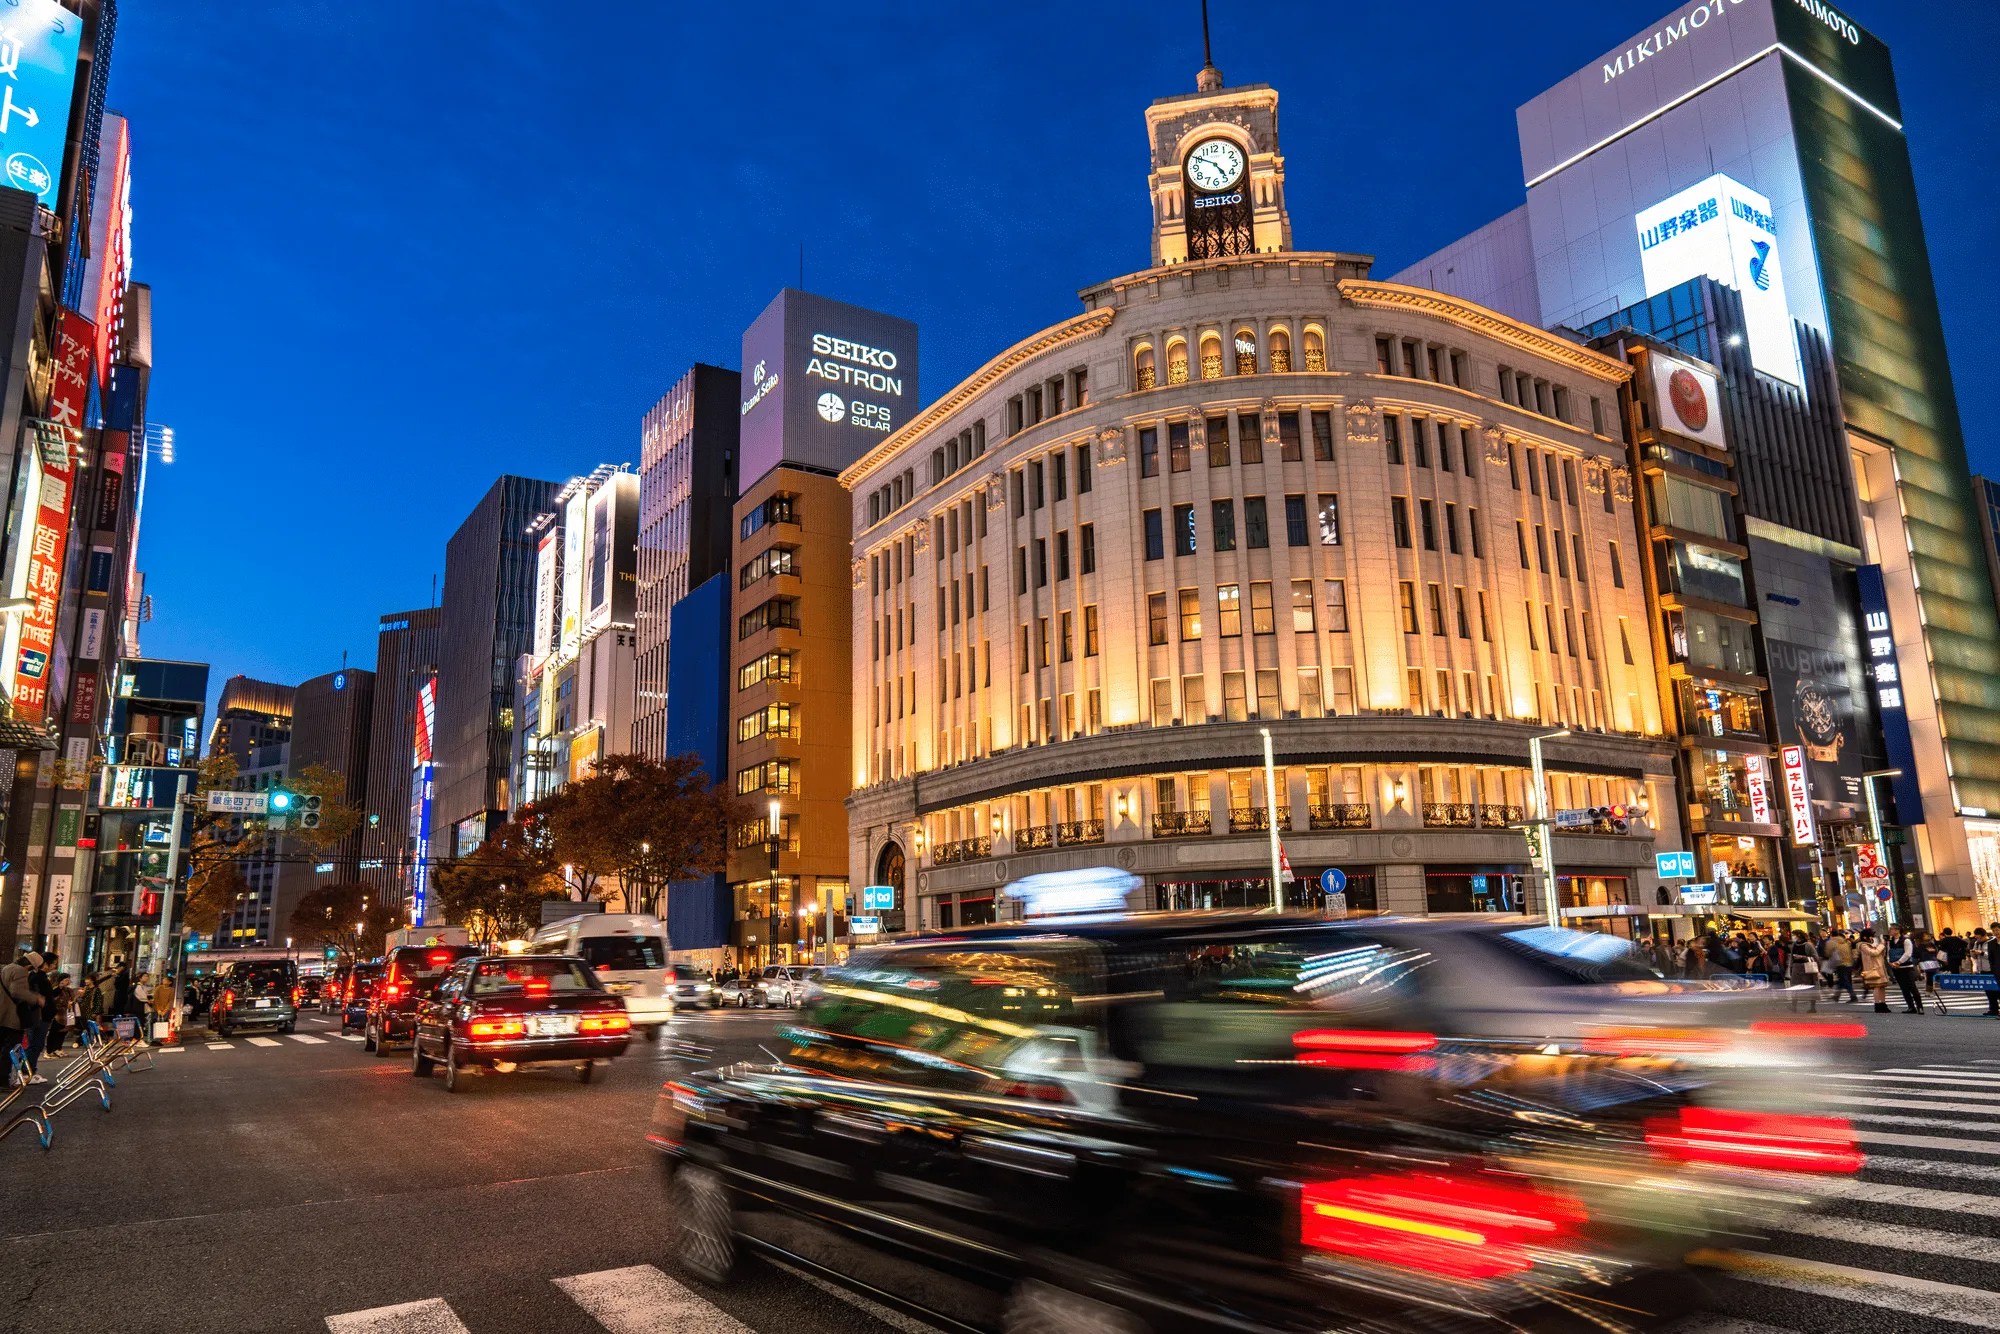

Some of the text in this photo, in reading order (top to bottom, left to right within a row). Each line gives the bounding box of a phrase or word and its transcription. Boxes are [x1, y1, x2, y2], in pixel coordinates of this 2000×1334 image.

[1794, 0, 1859, 45] KIMOTO
[1202, 148, 1209, 157] 11
[1210, 144, 1219, 154] 12
[1228, 150, 1235, 159] 2
[1192, 164, 1200, 173] 9
[1231, 159, 1238, 168] 3
[1196, 171, 1204, 180] 8
[1222, 174, 1229, 184] 5
[1229, 168, 1236, 176] 4
[1204, 176, 1211, 185] 7
[1212, 177, 1220, 187] 6
[1194, 193, 1242, 209] SEIKO
[1730, 196, 1778, 236] 山野楽器
[1640, 197, 1720, 252] 山野楽器
[812, 333, 898, 371] SEIKO
[805, 358, 903, 396] ASTRON
[760, 373, 779, 399] Seiko
[850, 400, 892, 422] GPS
[850, 416, 892, 433] SOLAR
[1865, 611, 1901, 708] 山野楽器
[19, 685, 45, 705] B1F
[212, 796, 265, 807] 銀座四丁目
[1788, 772, 1811, 840] キムラヤのパン
